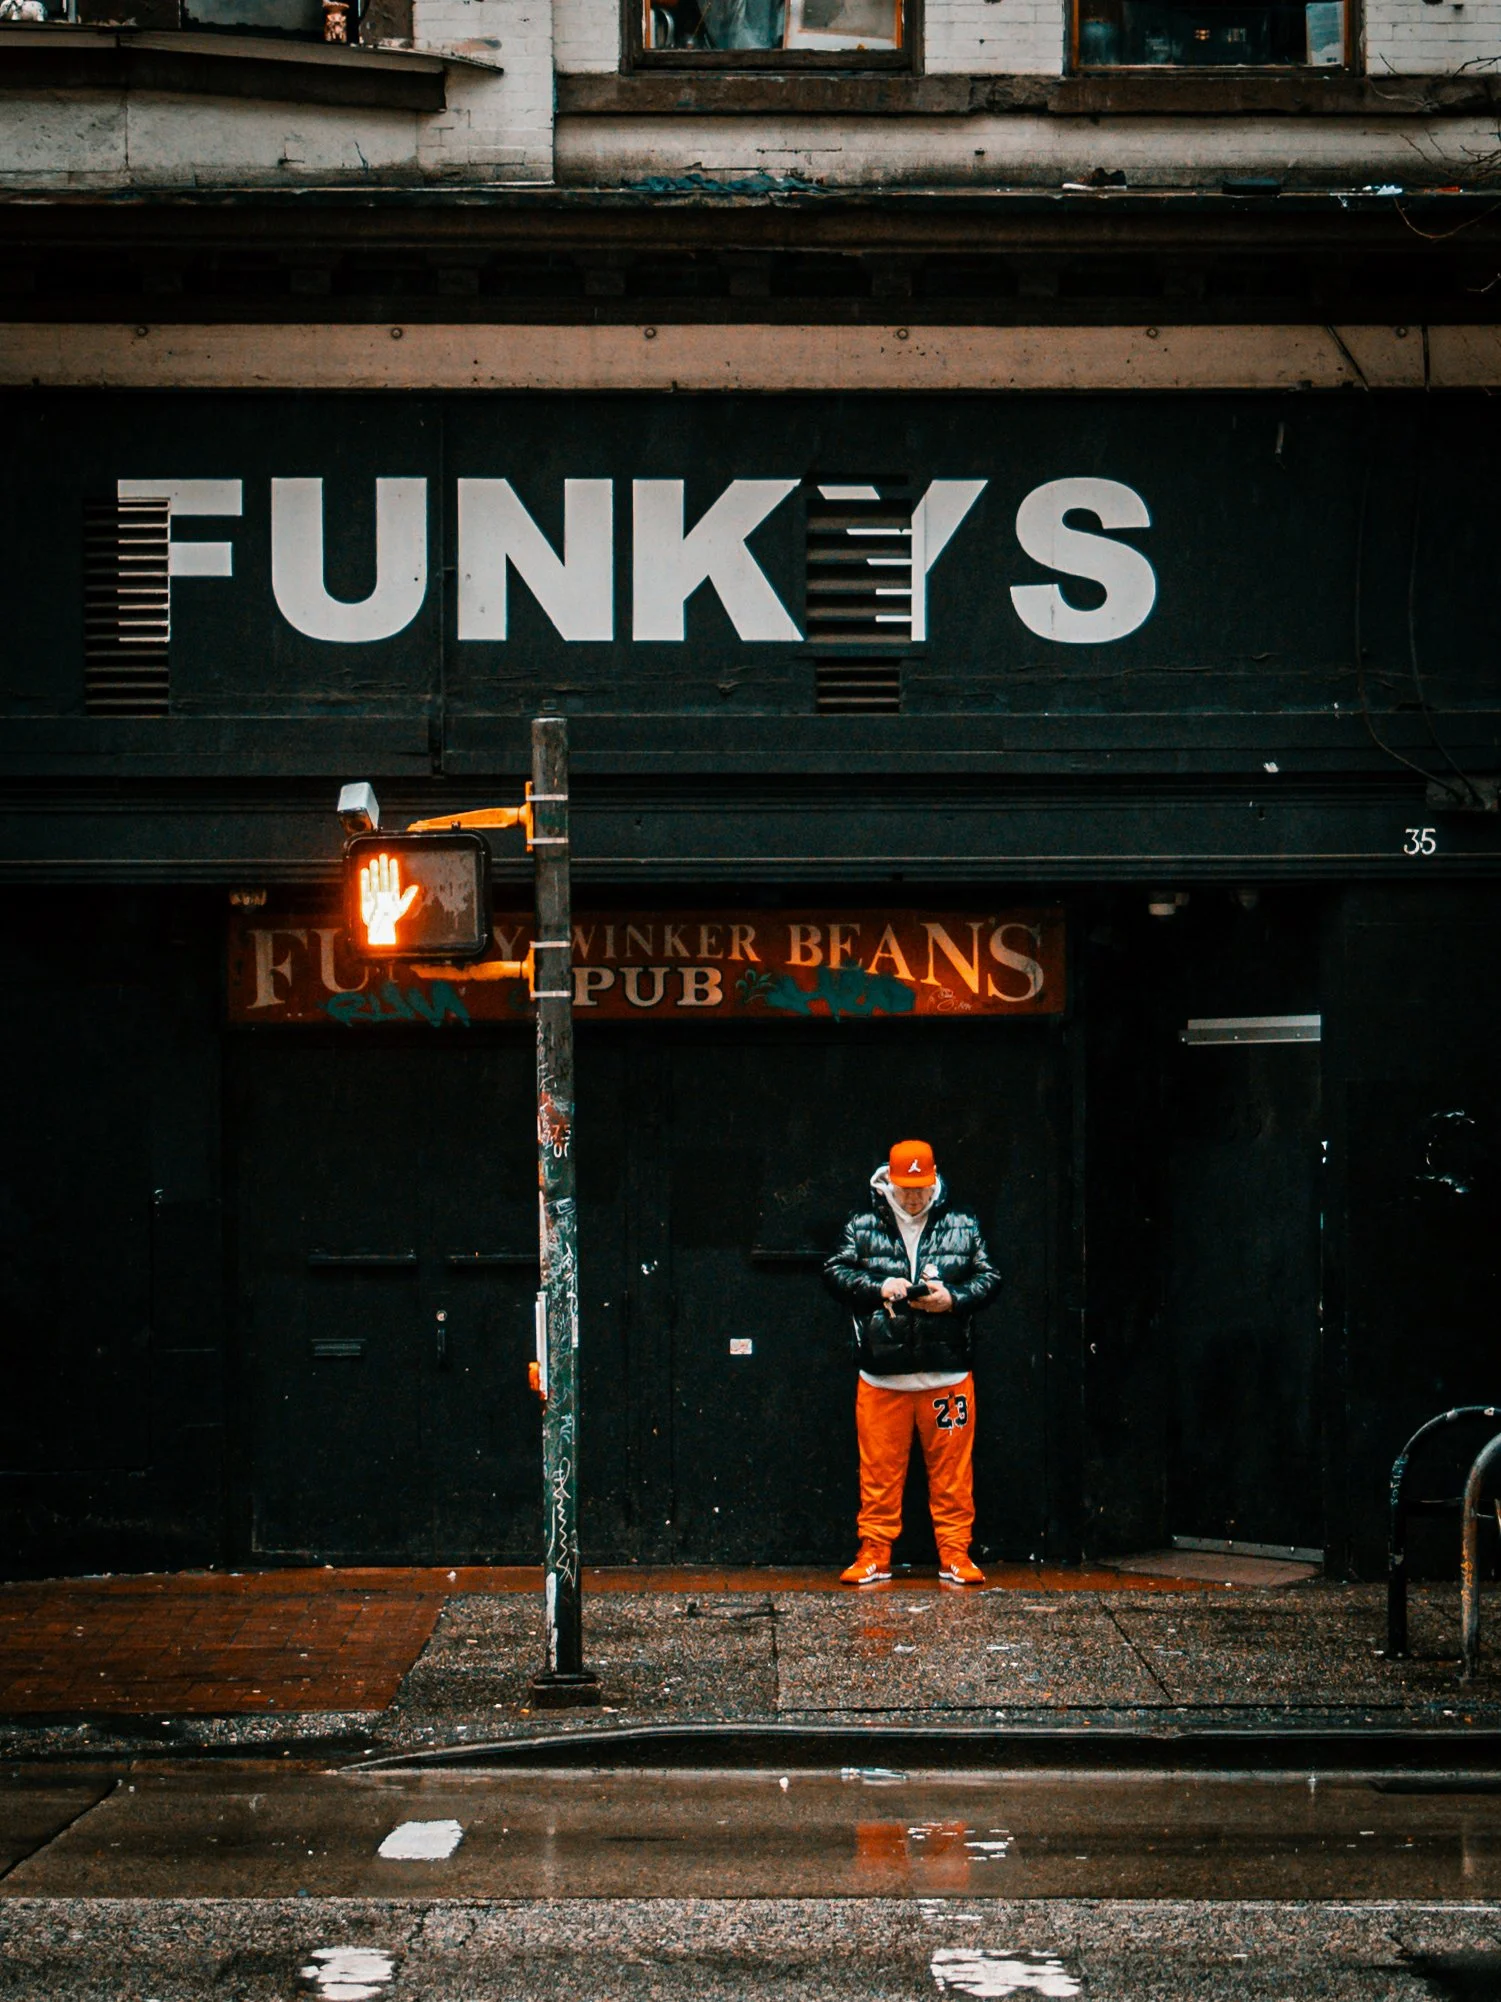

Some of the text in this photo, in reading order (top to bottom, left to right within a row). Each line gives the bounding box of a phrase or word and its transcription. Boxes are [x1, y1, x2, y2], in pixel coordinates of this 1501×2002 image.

[117, 476, 1157, 643] FUNKYS
[1403, 828, 1436, 855] 35
[246, 925, 525, 1010] FUY
[571, 966, 723, 1008] PUB
[932, 1393, 969, 1430] 23
